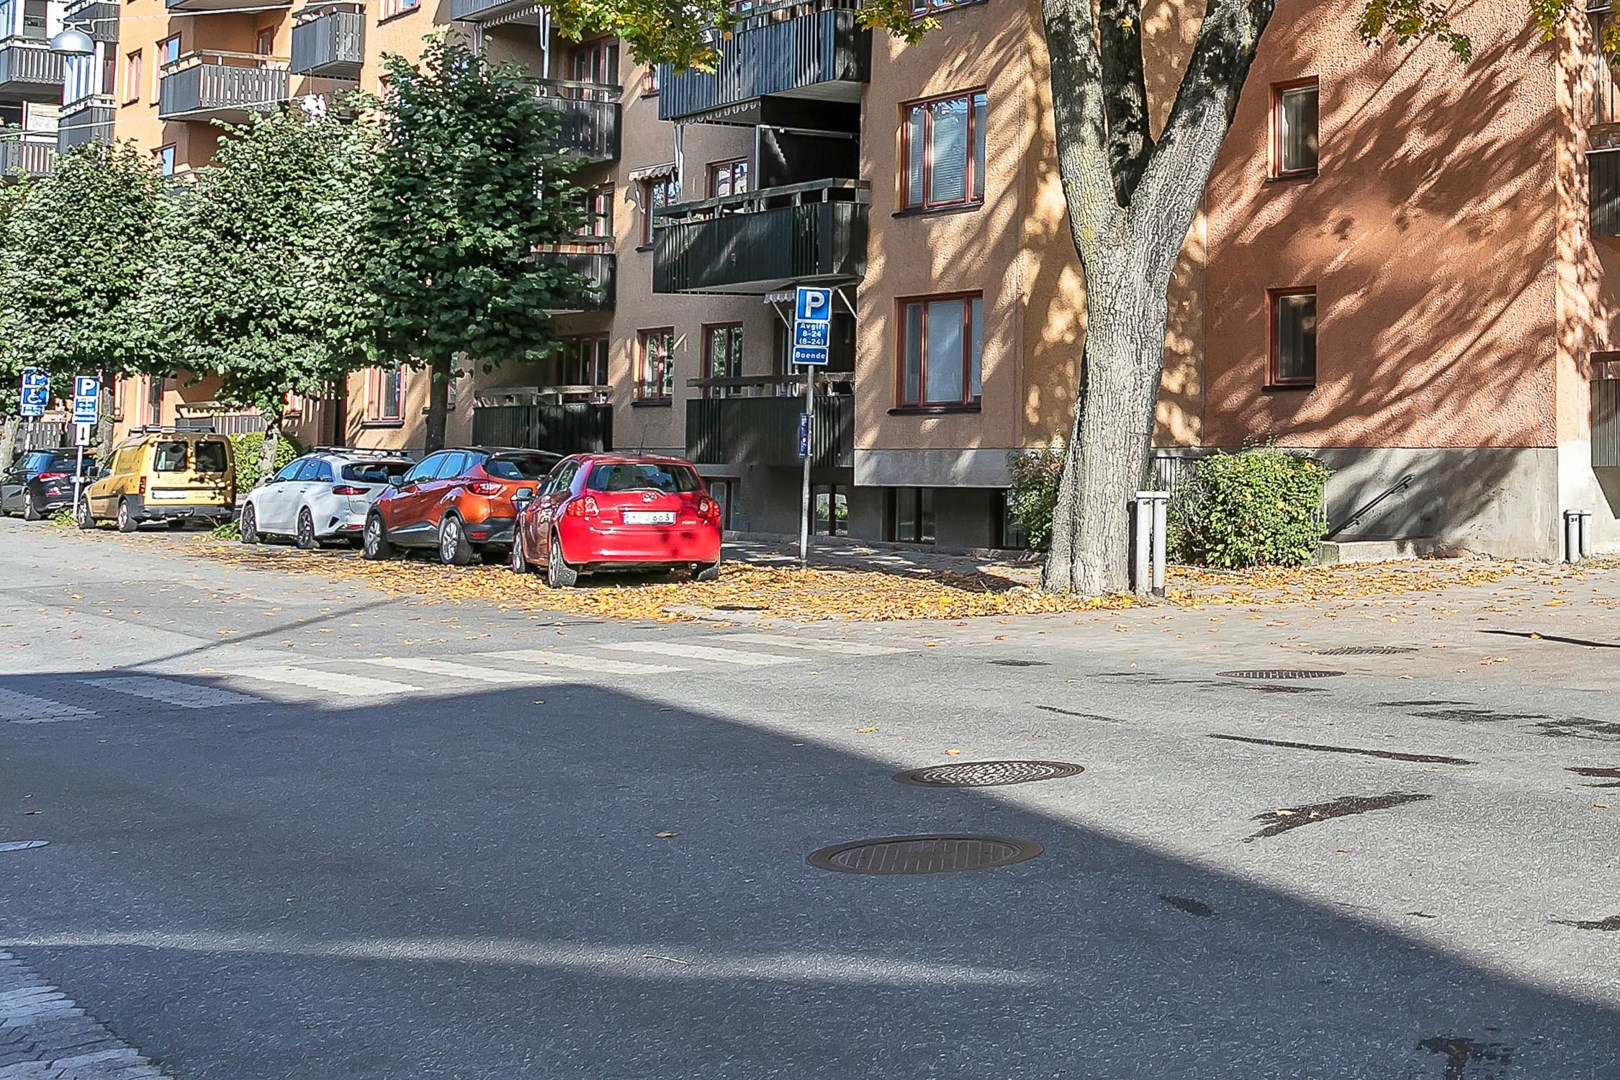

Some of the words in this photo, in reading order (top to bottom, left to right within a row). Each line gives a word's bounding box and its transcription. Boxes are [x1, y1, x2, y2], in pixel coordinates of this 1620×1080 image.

[804, 291, 825, 318] P
[795, 351, 826, 359] Boende
[80, 379, 96, 397] P
